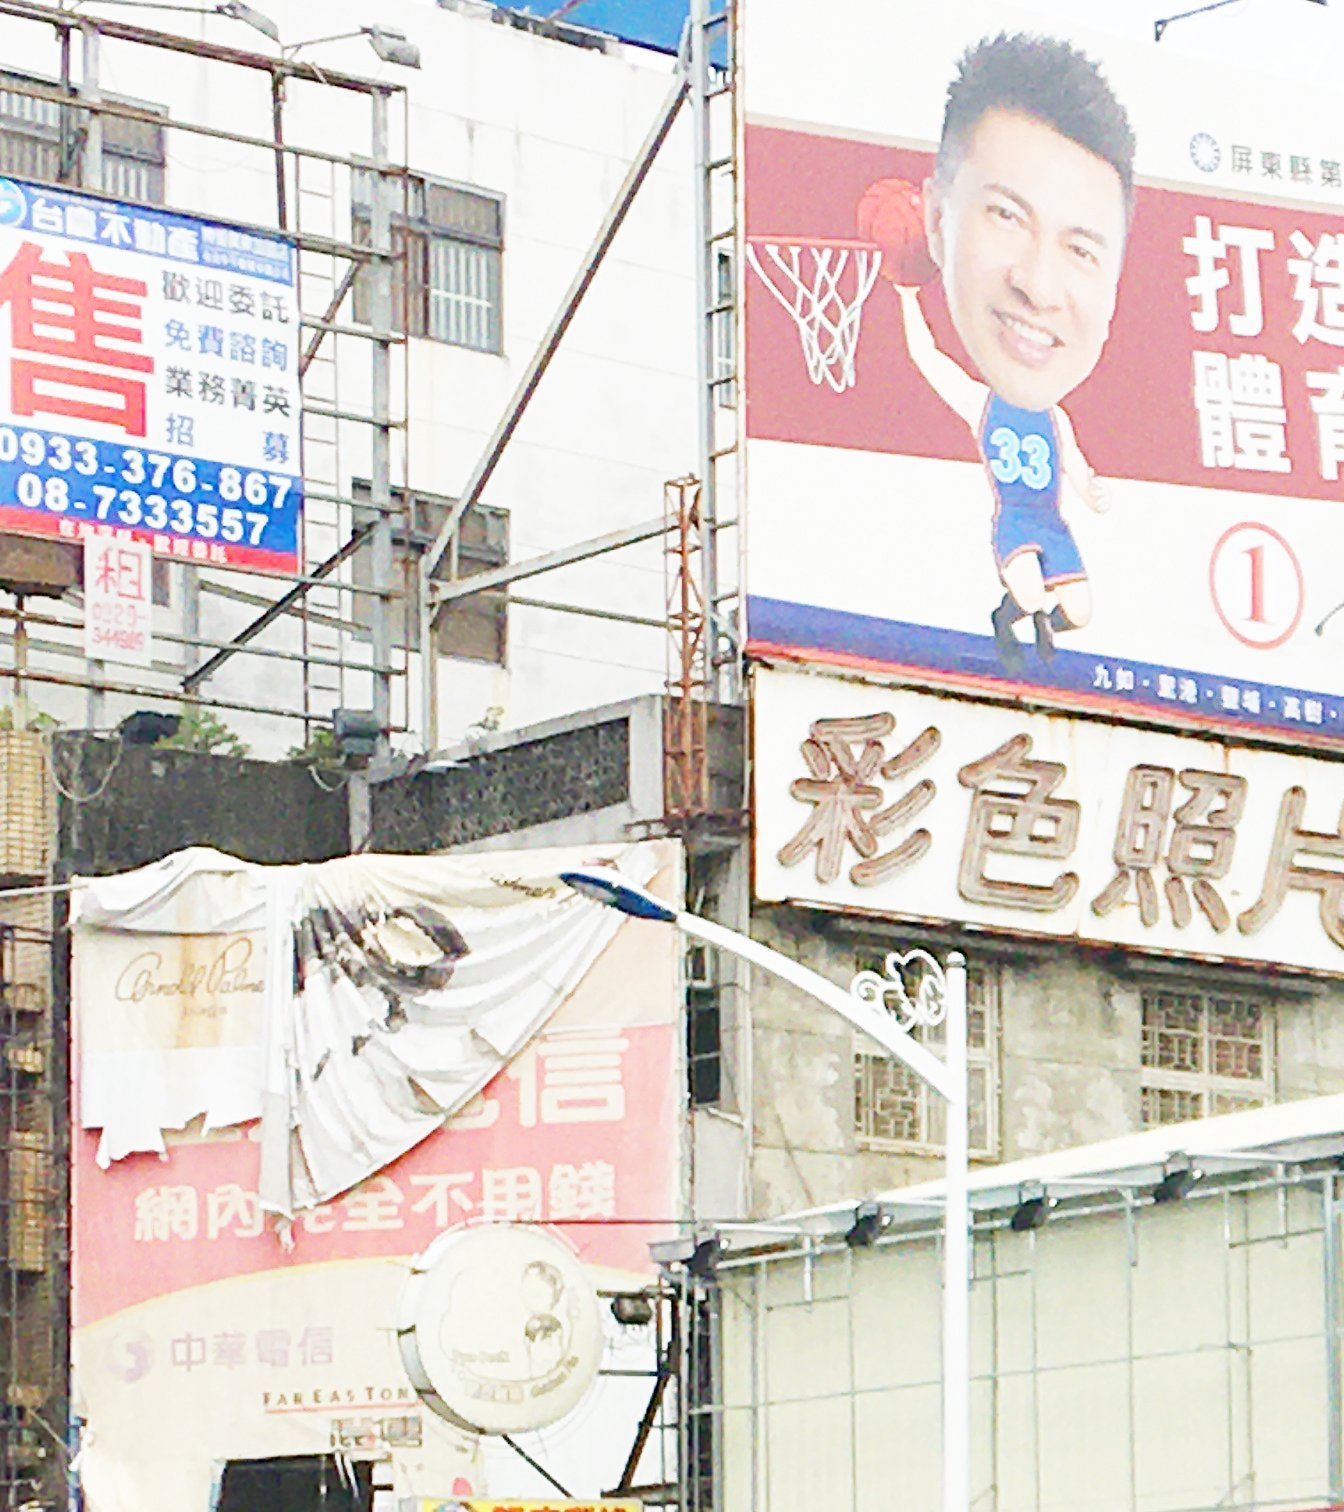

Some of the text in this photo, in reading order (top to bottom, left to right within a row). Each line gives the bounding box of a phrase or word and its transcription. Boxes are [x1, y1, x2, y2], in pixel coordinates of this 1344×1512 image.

[162, 270, 290, 324] 歡迎委託
[0, 241, 154, 437] 售
[164, 319, 288, 371] 免費諮詢
[166, 366, 291, 418] 業務菁英
[0, 427, 292, 509] 0933-376-867
[990, 426, 1052, 492] 33
[18, 473, 269, 545] 08-7333557
